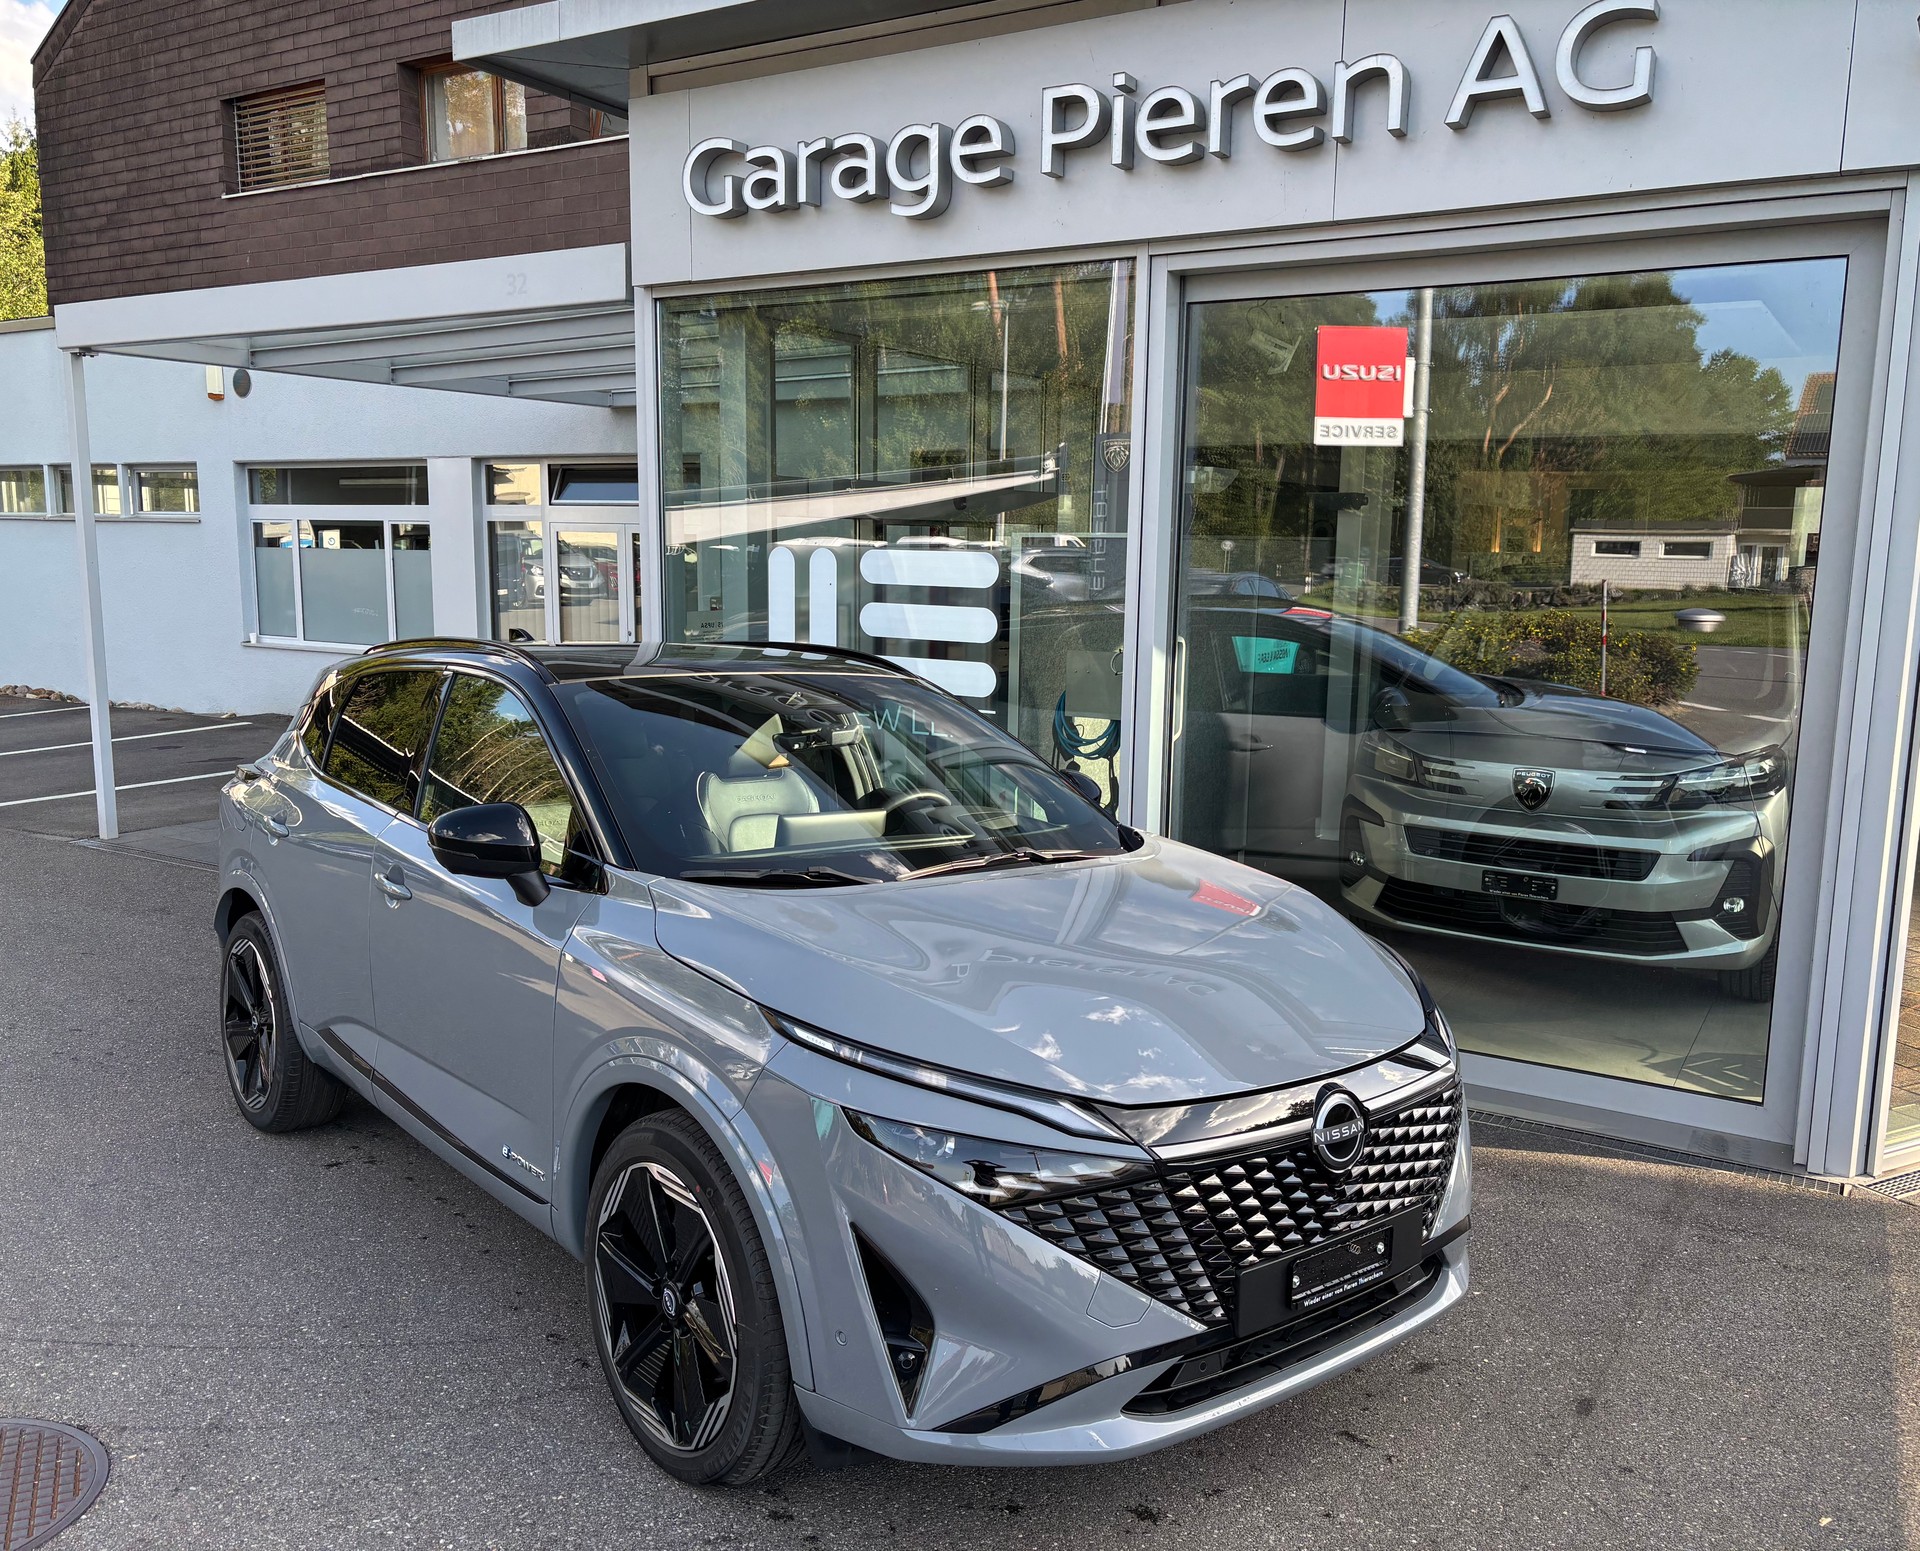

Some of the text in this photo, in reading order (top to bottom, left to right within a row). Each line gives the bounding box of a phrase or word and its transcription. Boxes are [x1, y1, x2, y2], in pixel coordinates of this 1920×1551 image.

[682, 0, 1660, 220] Garage Pieren AG
[506, 272, 528, 297] 32
[1314, 1117, 1365, 1144] NISSAN
[1303, 1296, 1321, 1307] Wieder
[1322, 1291, 1334, 1300] einer
[1334, 1287, 1343, 1296] von
[1343, 1282, 1358, 1291] Pieren
